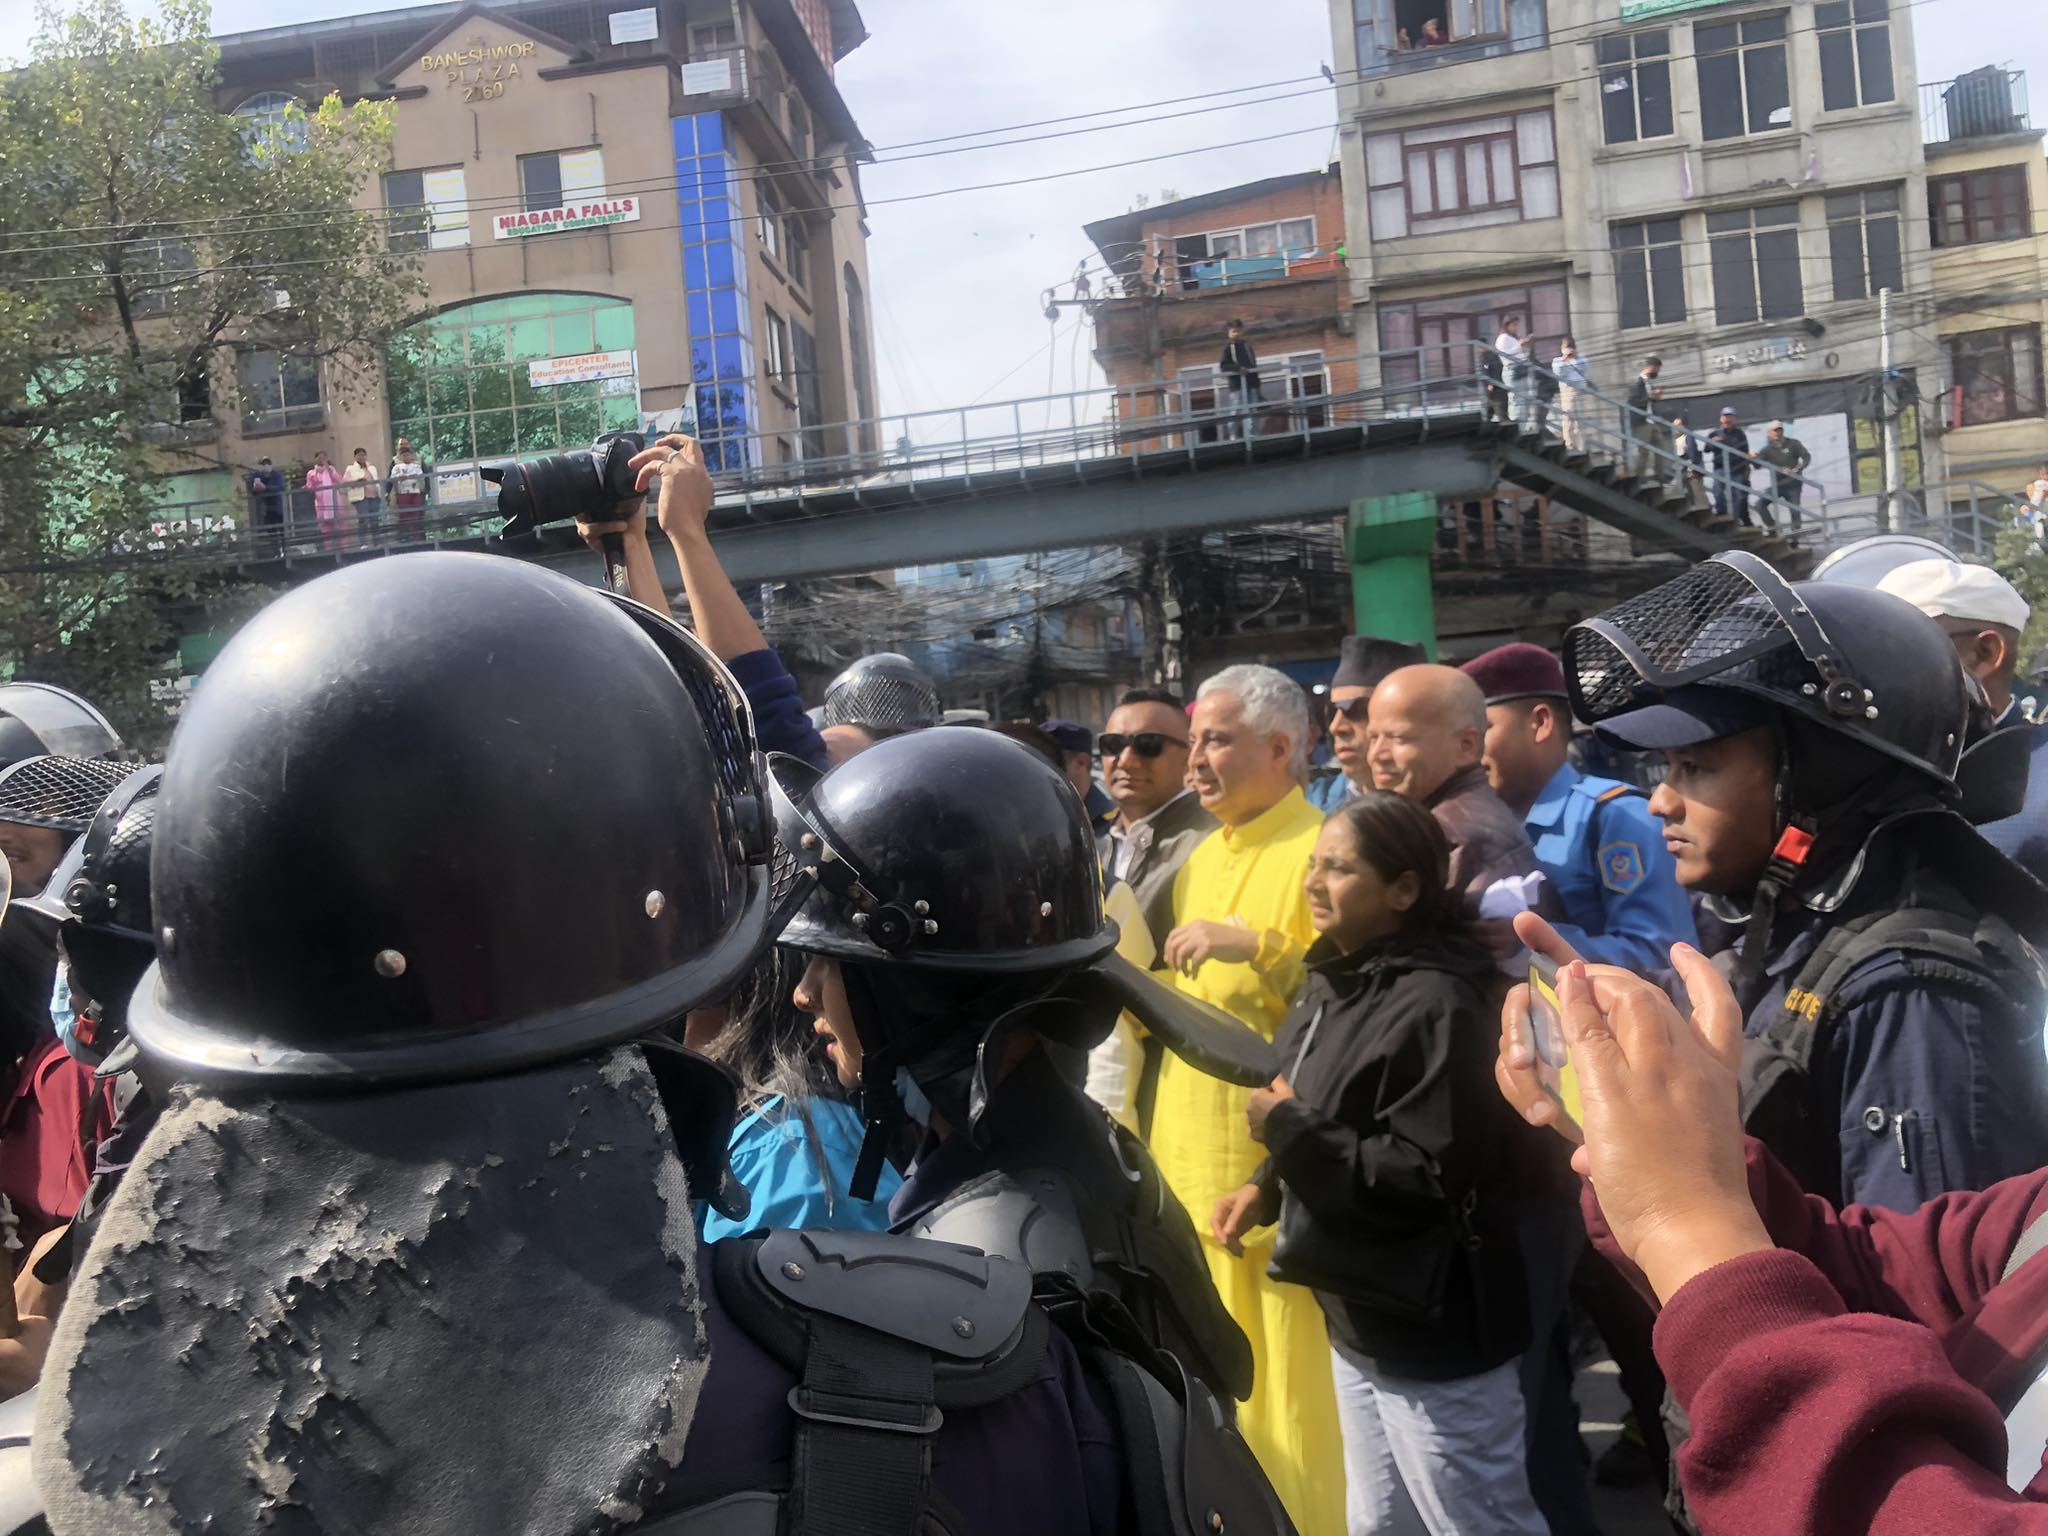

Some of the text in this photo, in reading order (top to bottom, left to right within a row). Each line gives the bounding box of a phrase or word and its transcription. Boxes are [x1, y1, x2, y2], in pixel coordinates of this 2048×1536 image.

[421, 41, 535, 72] BANESHWOR
[447, 62, 520, 87] PLAZA
[499, 199, 634, 230] NIAGARA FALLS
[506, 212, 627, 237] EDUCATION CONSULTANCY
[531, 366, 576, 379] Education
[578, 360, 631, 374] Consultants
[551, 354, 609, 369] EPICENTER
